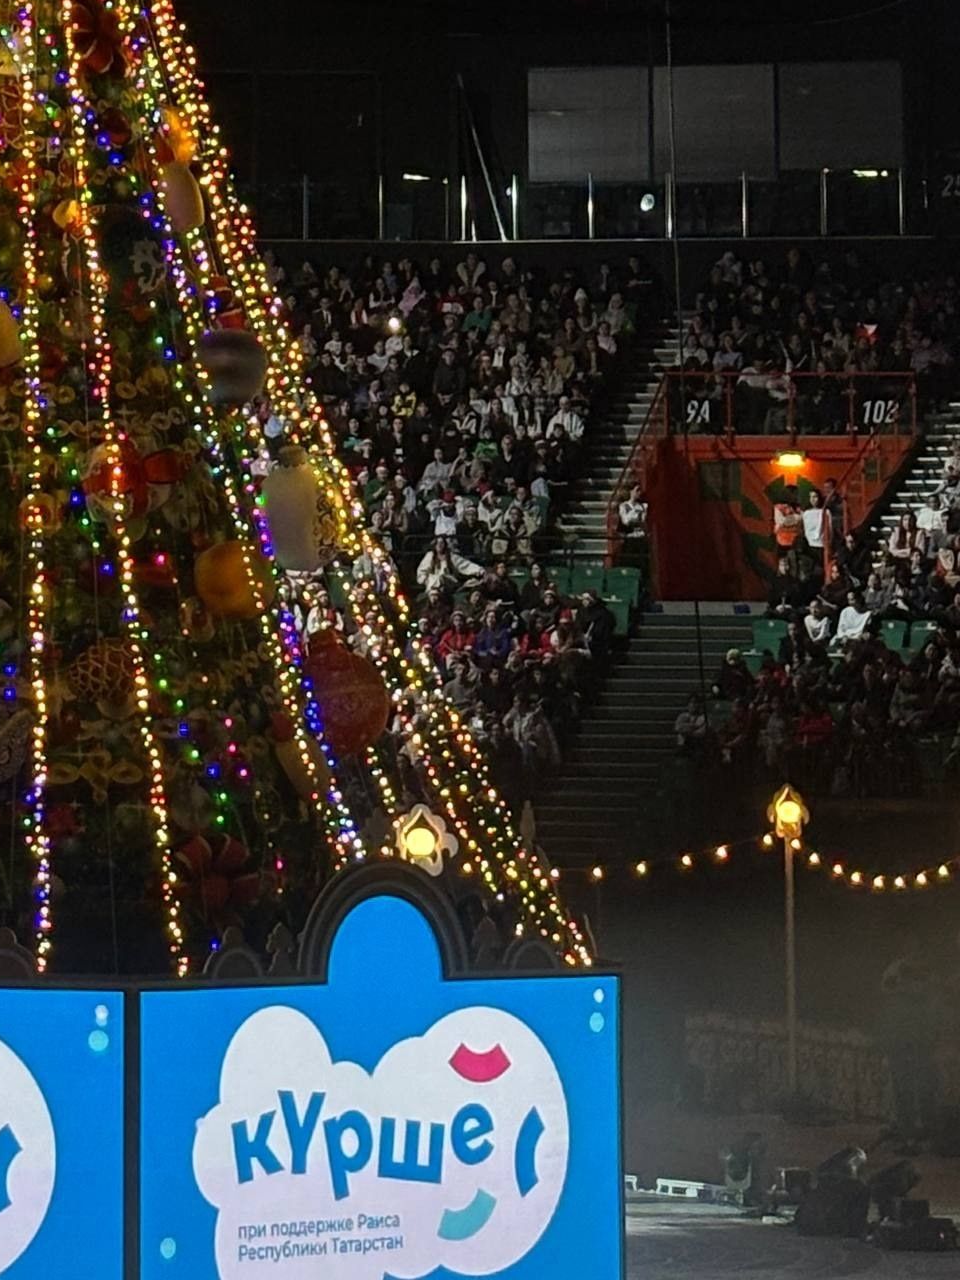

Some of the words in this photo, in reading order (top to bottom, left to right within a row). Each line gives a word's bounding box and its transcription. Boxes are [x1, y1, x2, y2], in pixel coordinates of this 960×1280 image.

[686, 399, 711, 424] 9A
[238, 1224, 267, 1241] при
[270, 1218, 354, 1238] поддержке
[357, 1213, 401, 1230] Раиса
[238, 1239, 328, 1263] Республики
[331, 1234, 404, 1255] Татарстан
